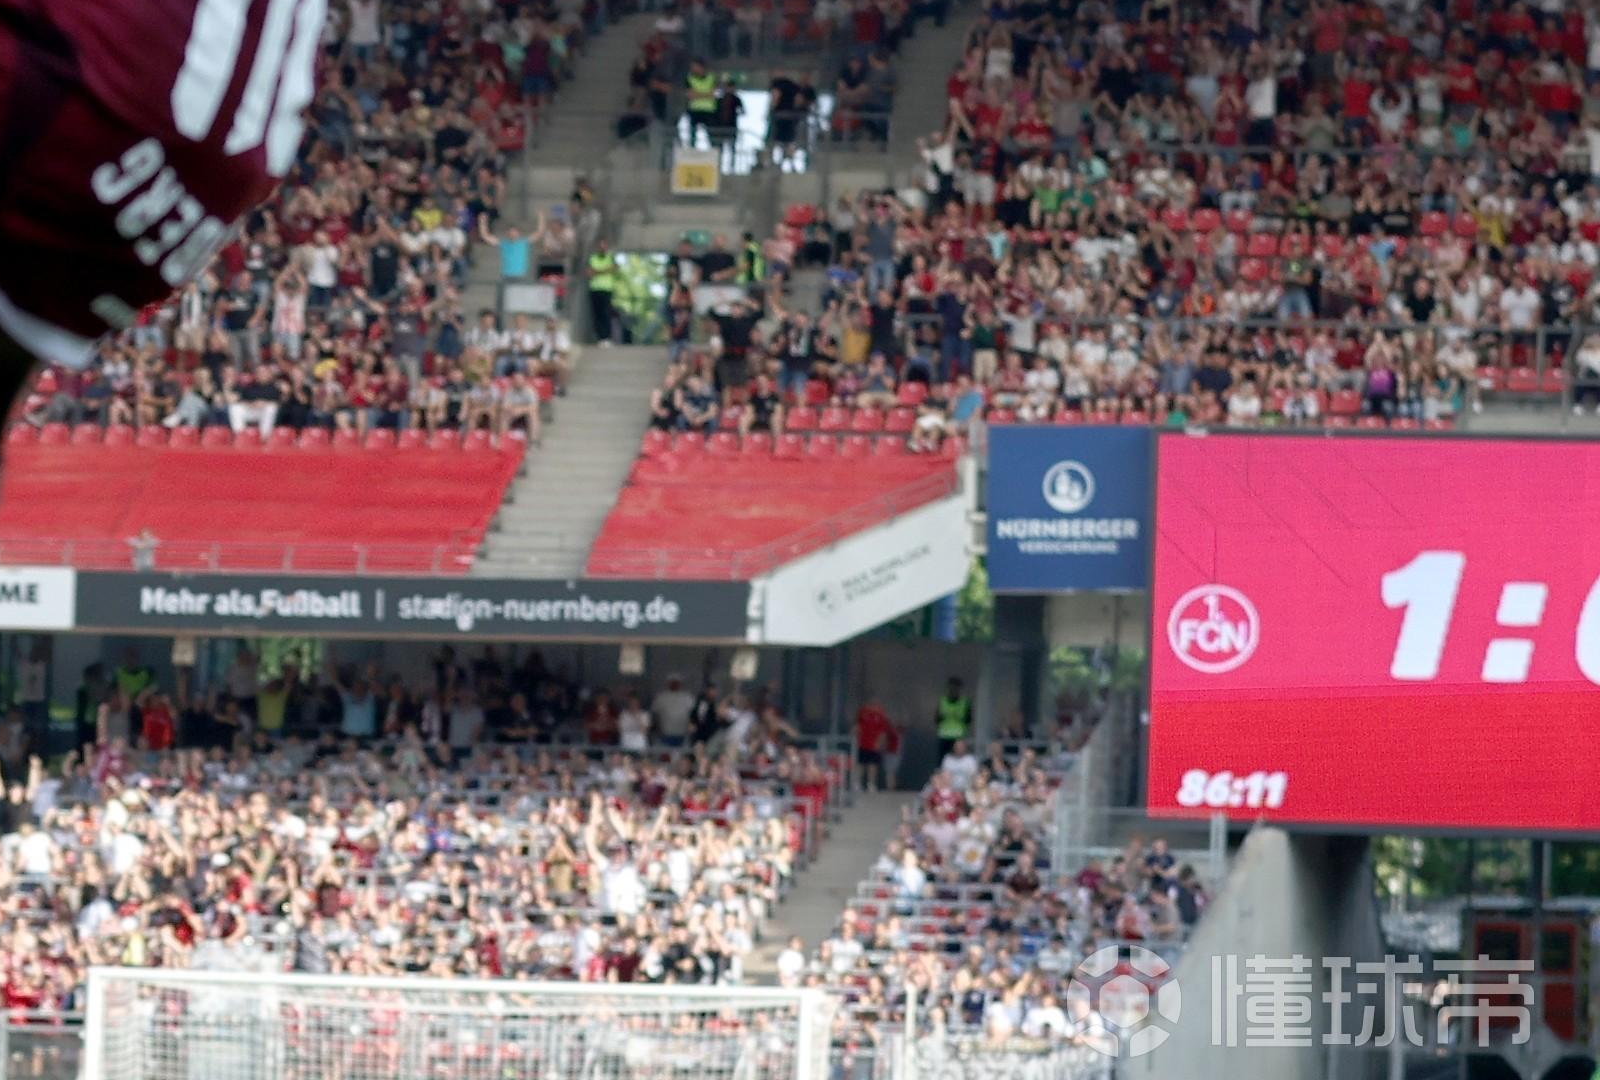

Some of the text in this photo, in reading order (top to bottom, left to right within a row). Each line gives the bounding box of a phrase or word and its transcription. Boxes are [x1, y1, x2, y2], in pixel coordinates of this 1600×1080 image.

[997, 517, 1140, 540] NÜRNBERGER
[140, 587, 211, 614] Mehr
[399, 594, 680, 629] stadion-nuernberg.de
[1179, 619, 1248, 653] FCN
[1177, 769, 1288, 808] 86:11
